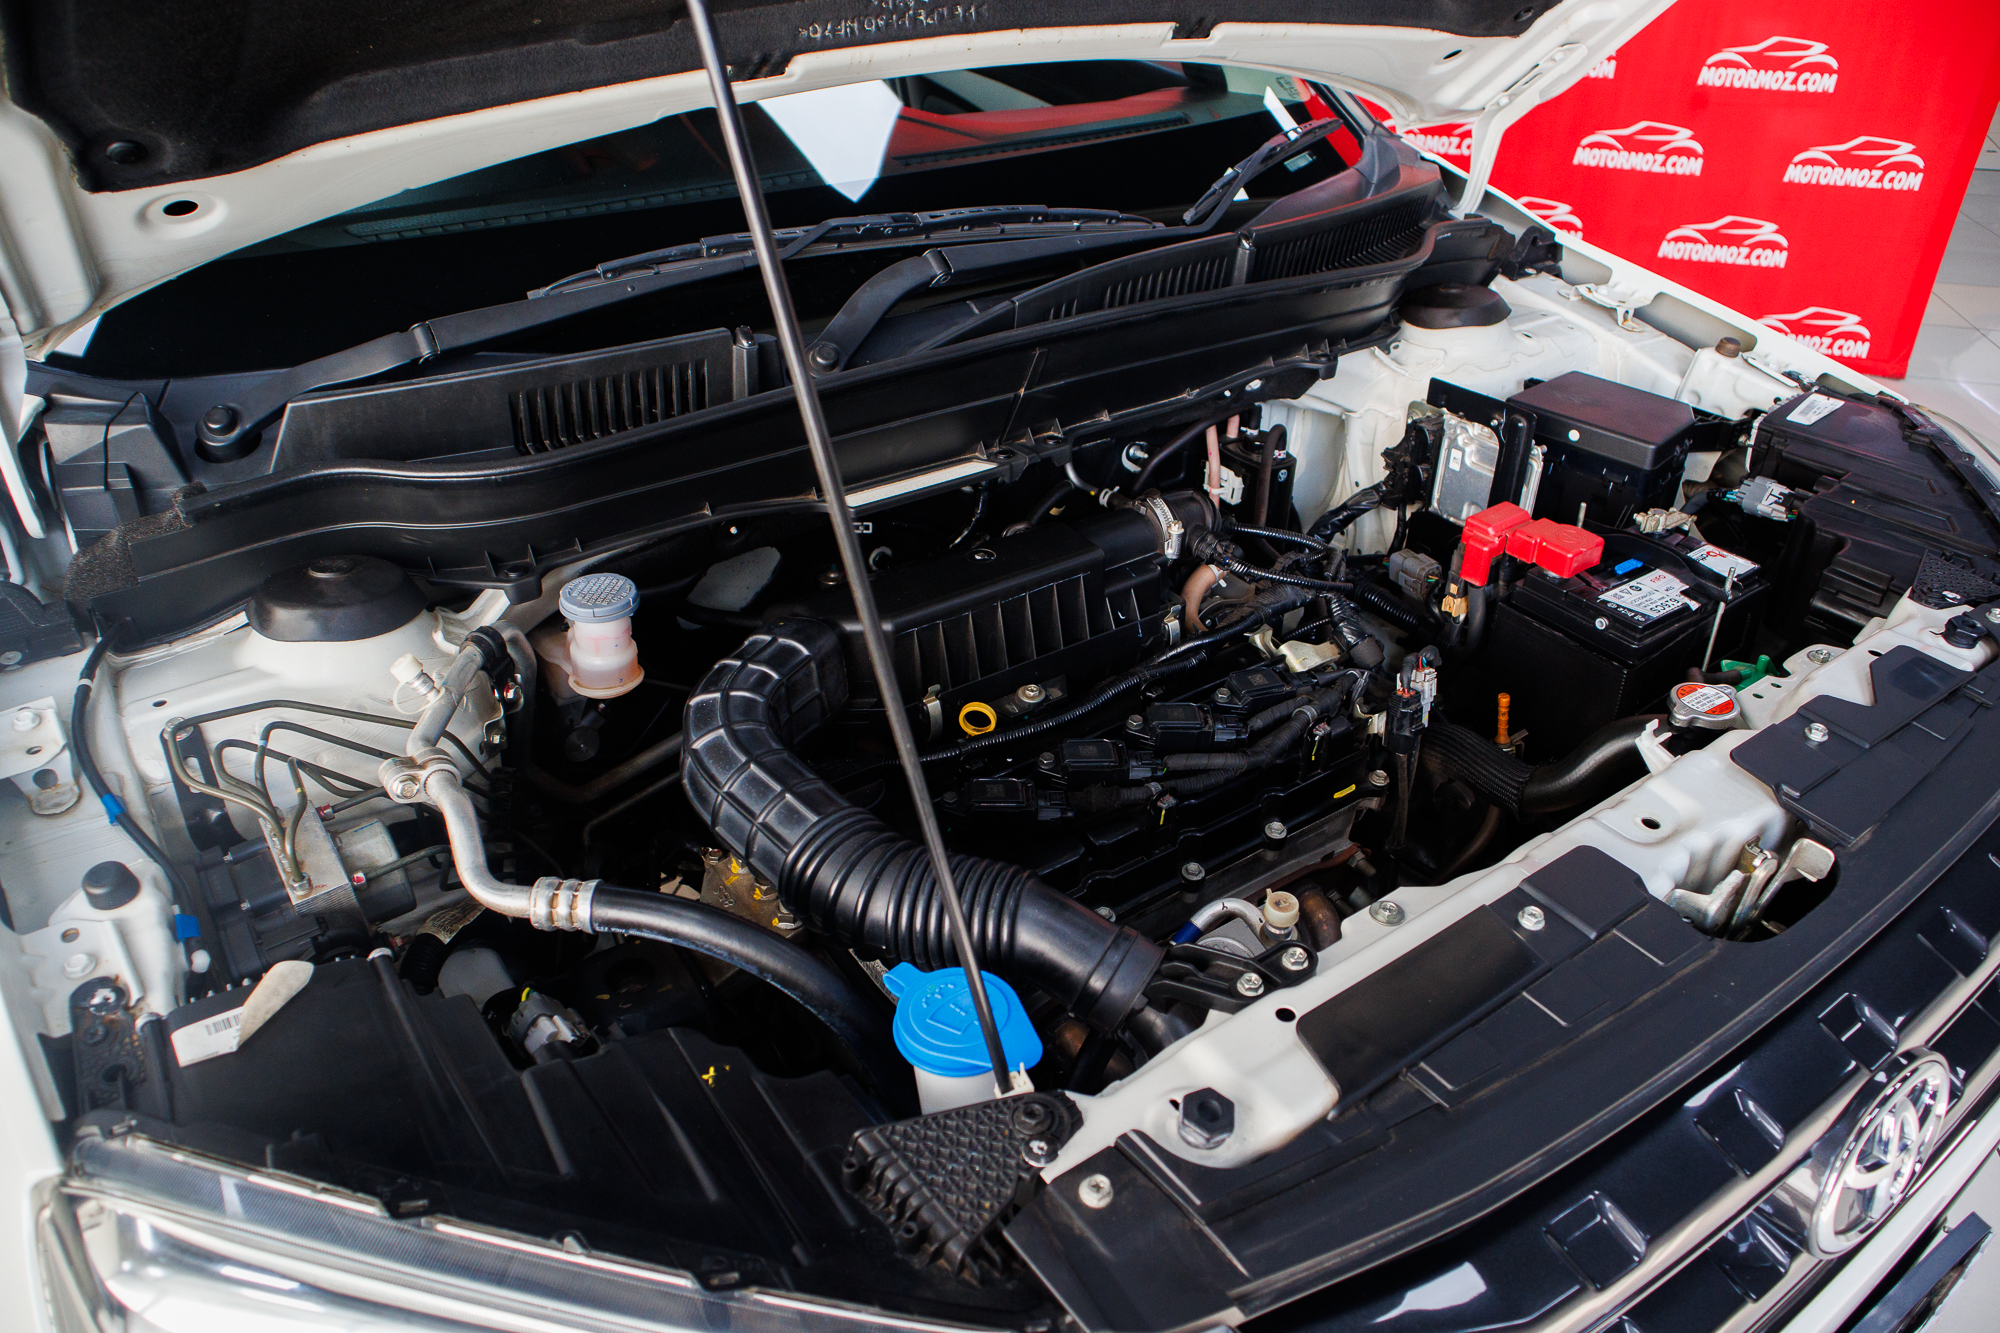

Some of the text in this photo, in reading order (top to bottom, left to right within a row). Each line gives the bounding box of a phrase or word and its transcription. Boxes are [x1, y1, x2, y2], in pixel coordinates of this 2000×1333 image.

[1697, 66, 1838, 93] MOTORMOZ.COM
[1572, 146, 1704, 176] MOTORMOZ.COM
[1783, 163, 1924, 191] MOTORMOZ.COM
[1657, 240, 1788, 269] MOTORMOZ.COM
